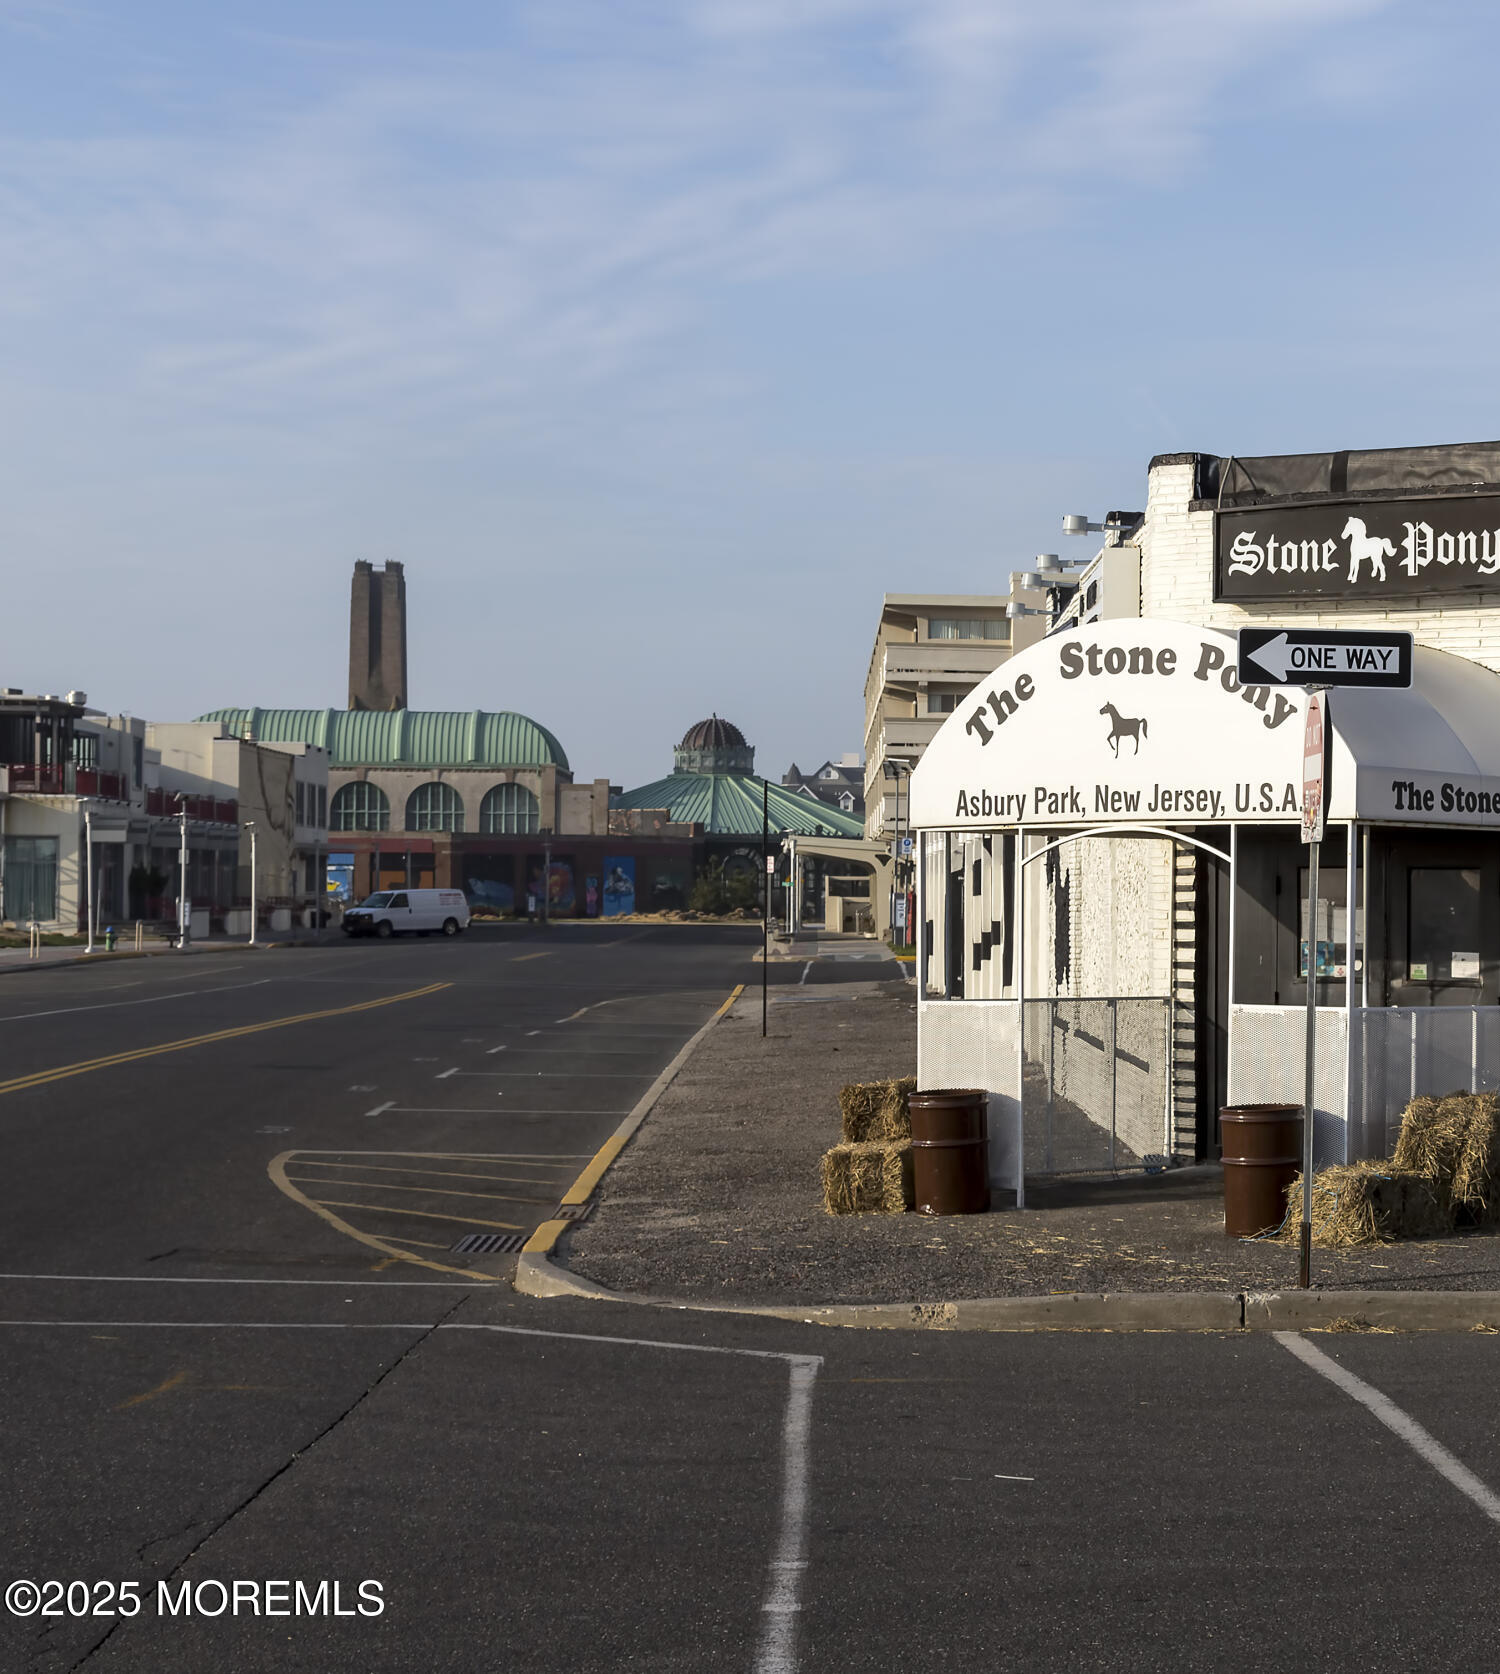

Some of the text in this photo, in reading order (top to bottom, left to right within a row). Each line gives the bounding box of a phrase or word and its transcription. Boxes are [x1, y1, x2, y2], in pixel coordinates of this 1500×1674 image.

[1228, 530, 1340, 576] Stone
[1291, 646, 1393, 670] ONE WAY
[965, 641, 1298, 746] The Stone Pony
[956, 782, 1303, 821] Asbury Park, New Jersey, U.S.A.
[1392, 781, 1435, 812] The
